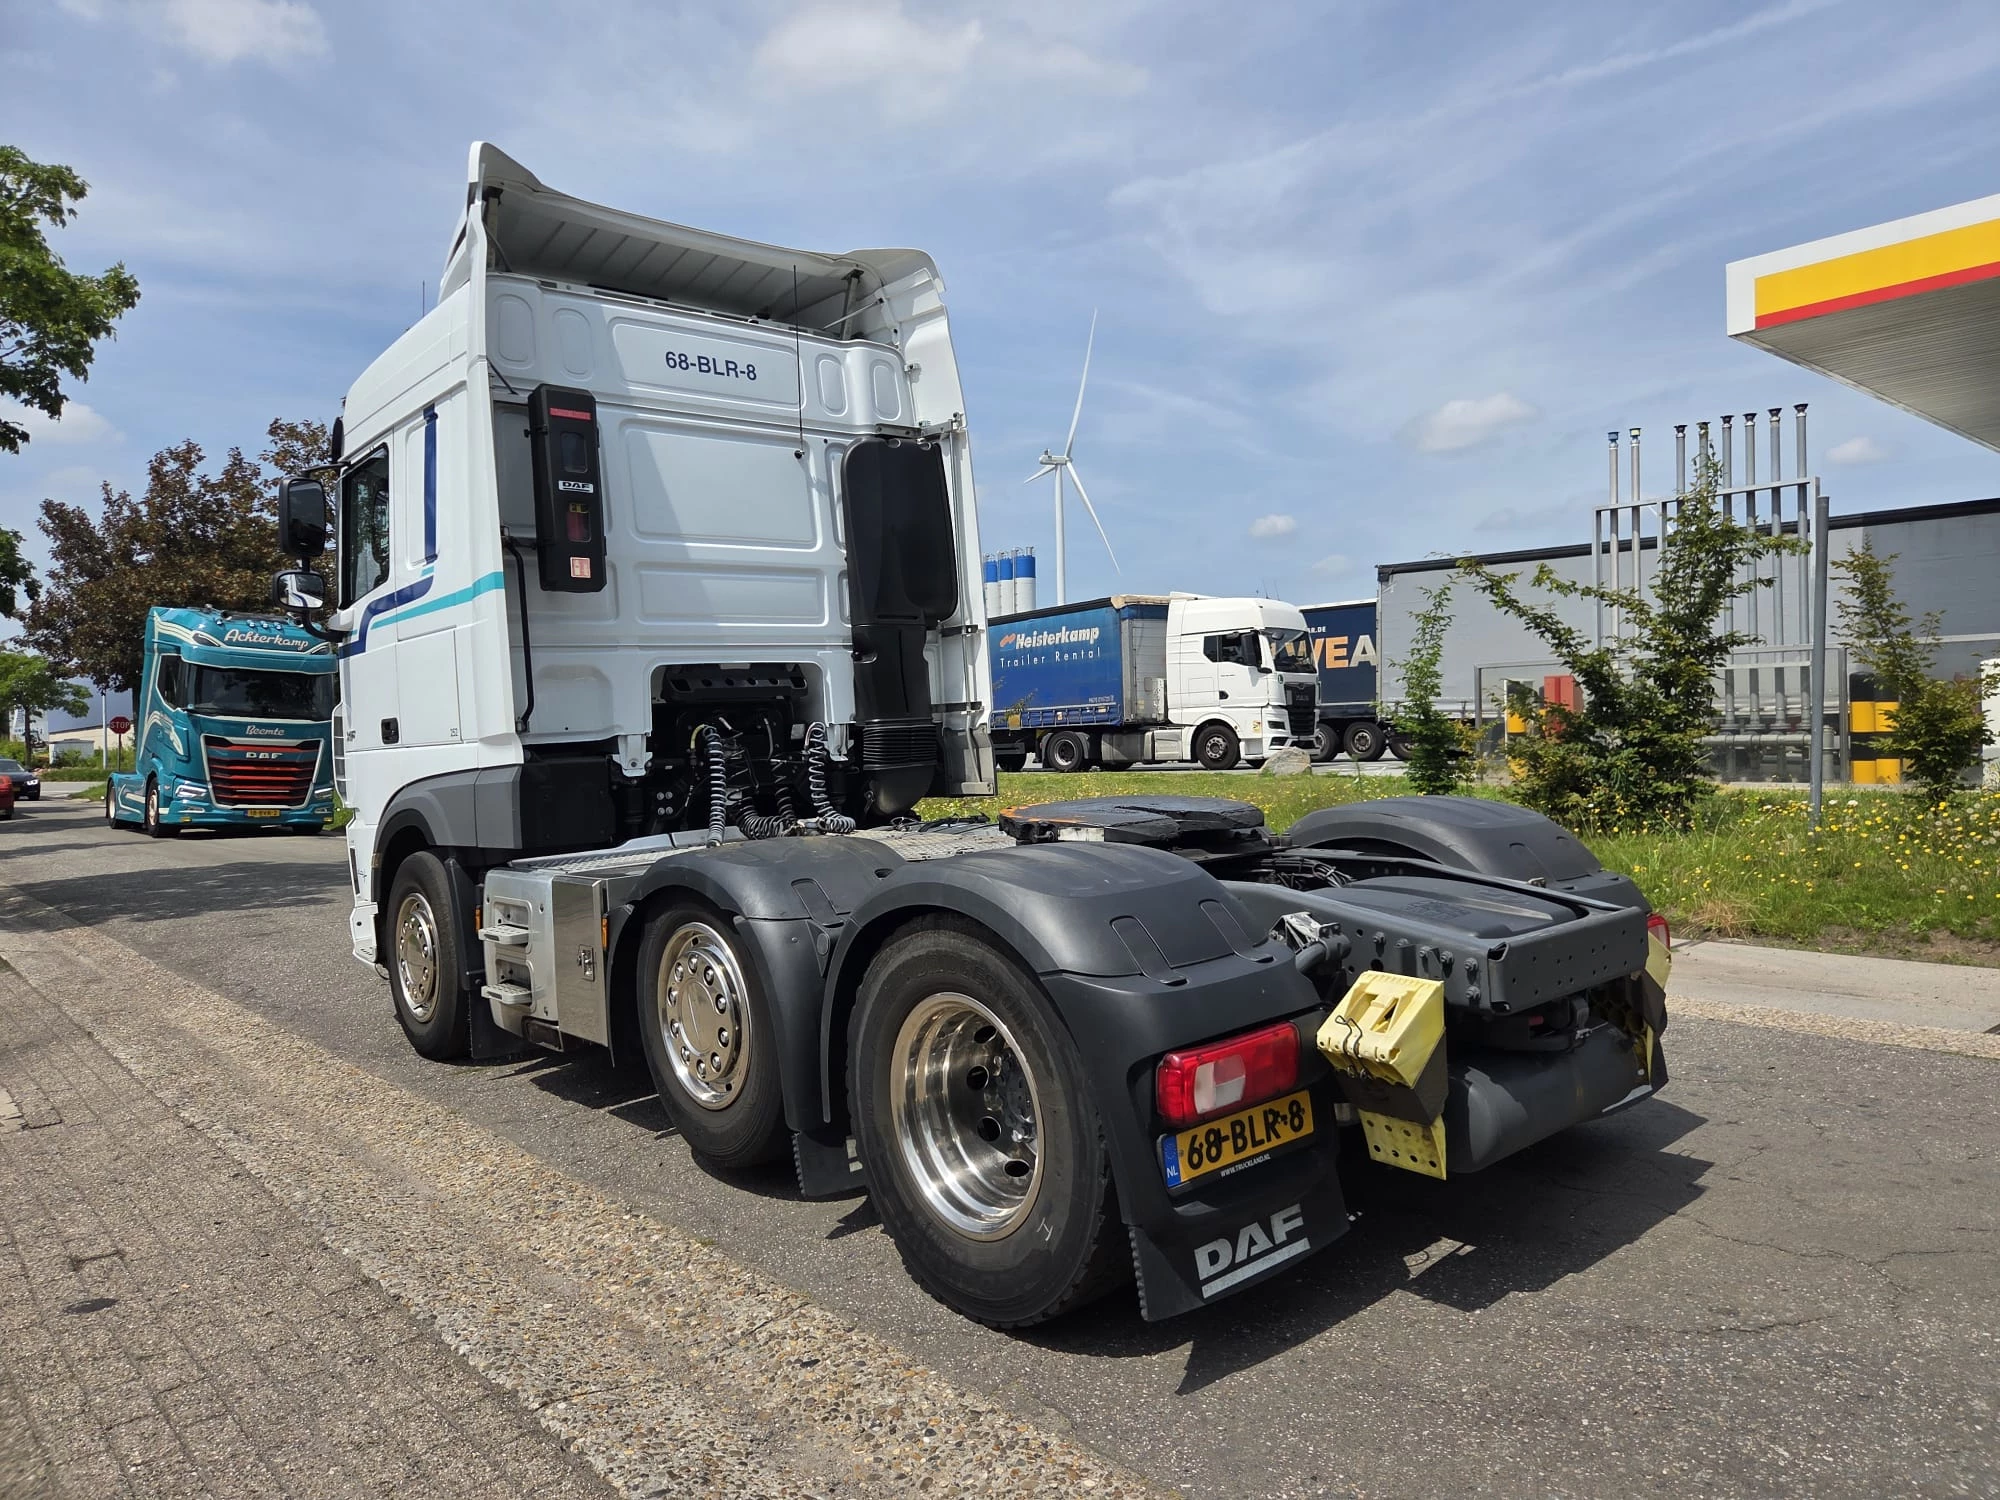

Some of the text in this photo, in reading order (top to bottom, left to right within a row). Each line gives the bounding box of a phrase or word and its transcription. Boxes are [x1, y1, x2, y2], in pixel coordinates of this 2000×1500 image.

[665, 351, 757, 381] 68-BLR-8
[562, 481, 590, 489] DAF
[224, 628, 309, 651] Achterkamp
[1015, 626, 1100, 645] Heisterkamp
[1000, 646, 1100, 669] Trailer Rental
[110, 721, 130, 729] STOP
[246, 751, 284, 759] DAF
[1187, 1100, 1305, 1170] 68-BLR-8
[1166, 1166, 1179, 1178] NL
[1220, 1153, 1271, 1177] WWW.TRUCKLAND.NL
[1194, 1204, 1304, 1280] DAF
